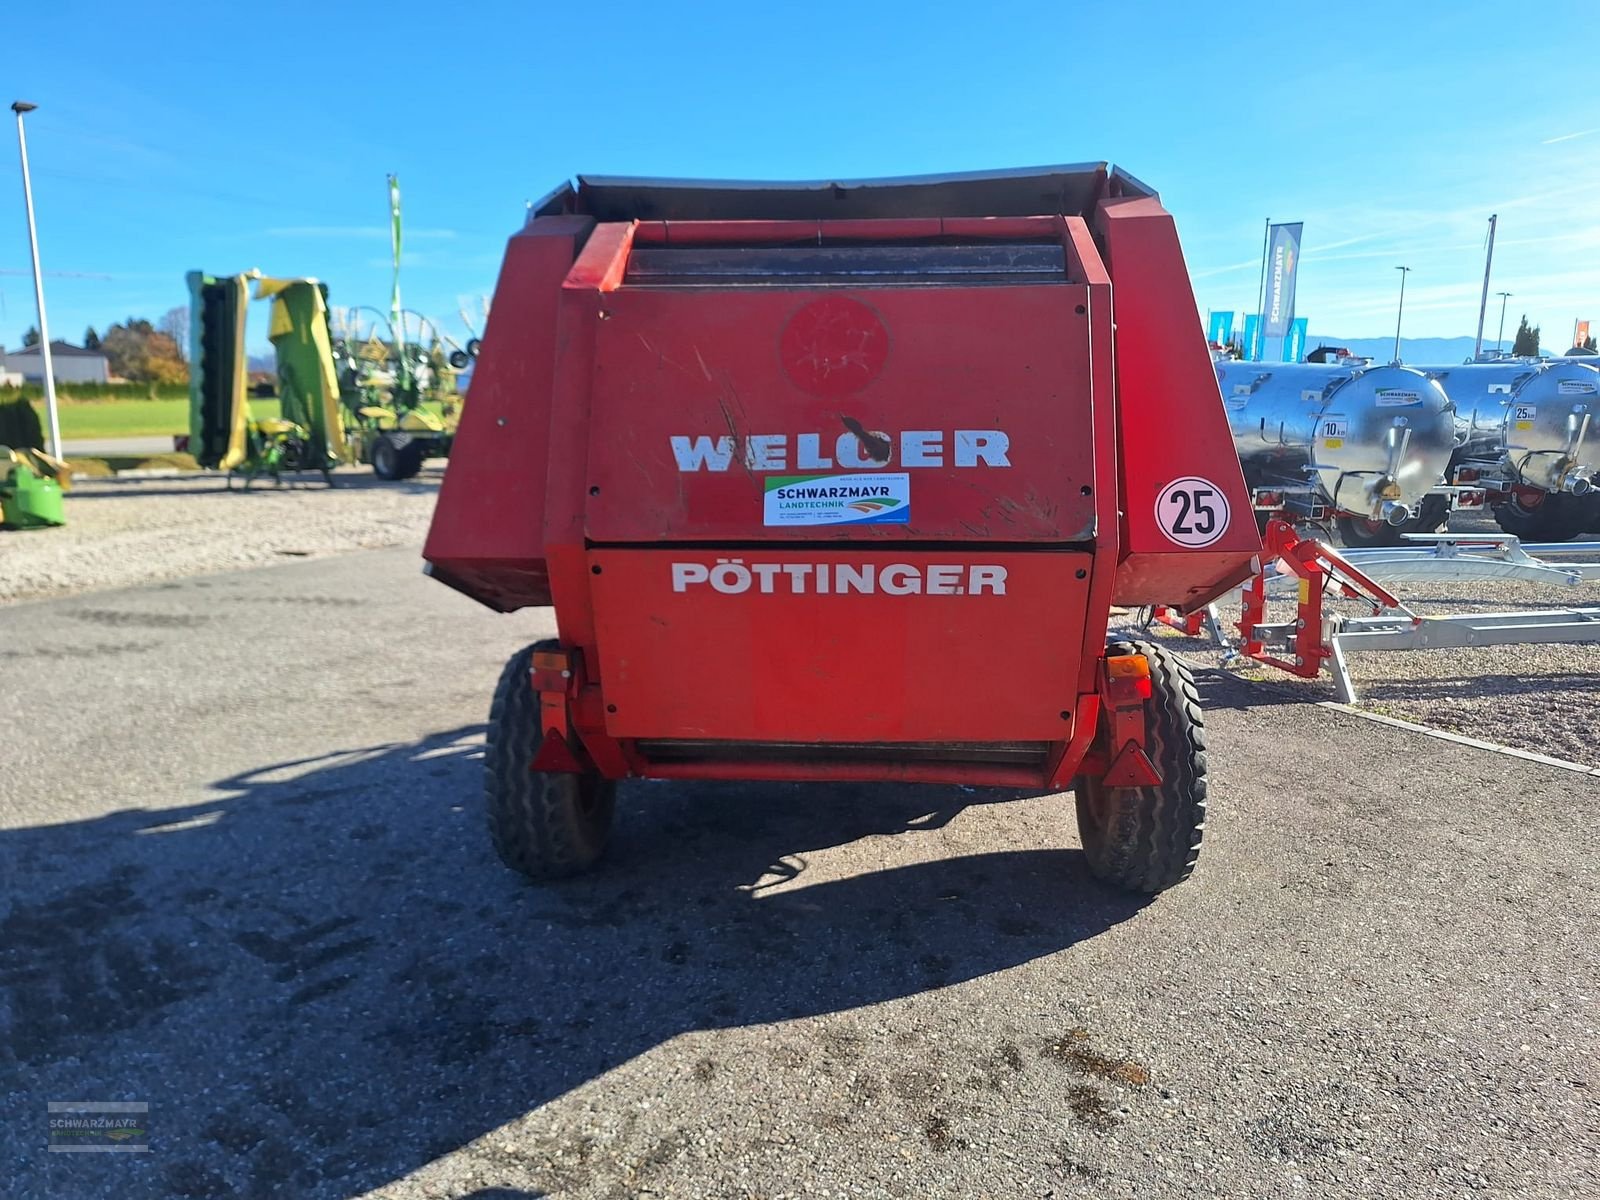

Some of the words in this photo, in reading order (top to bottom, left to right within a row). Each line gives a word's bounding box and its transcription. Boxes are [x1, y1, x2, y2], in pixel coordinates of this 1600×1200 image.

[1270, 246, 1284, 323] SCHWARZMAYR
[1517, 407, 1528, 419] 25
[1325, 422, 1337, 436] 10
[777, 486, 890, 499] SCHWARZMAYR
[779, 501, 845, 509] LANDTECHNIK
[1170, 490, 1215, 534] 25
[671, 558, 1008, 596] PÖTTINGER
